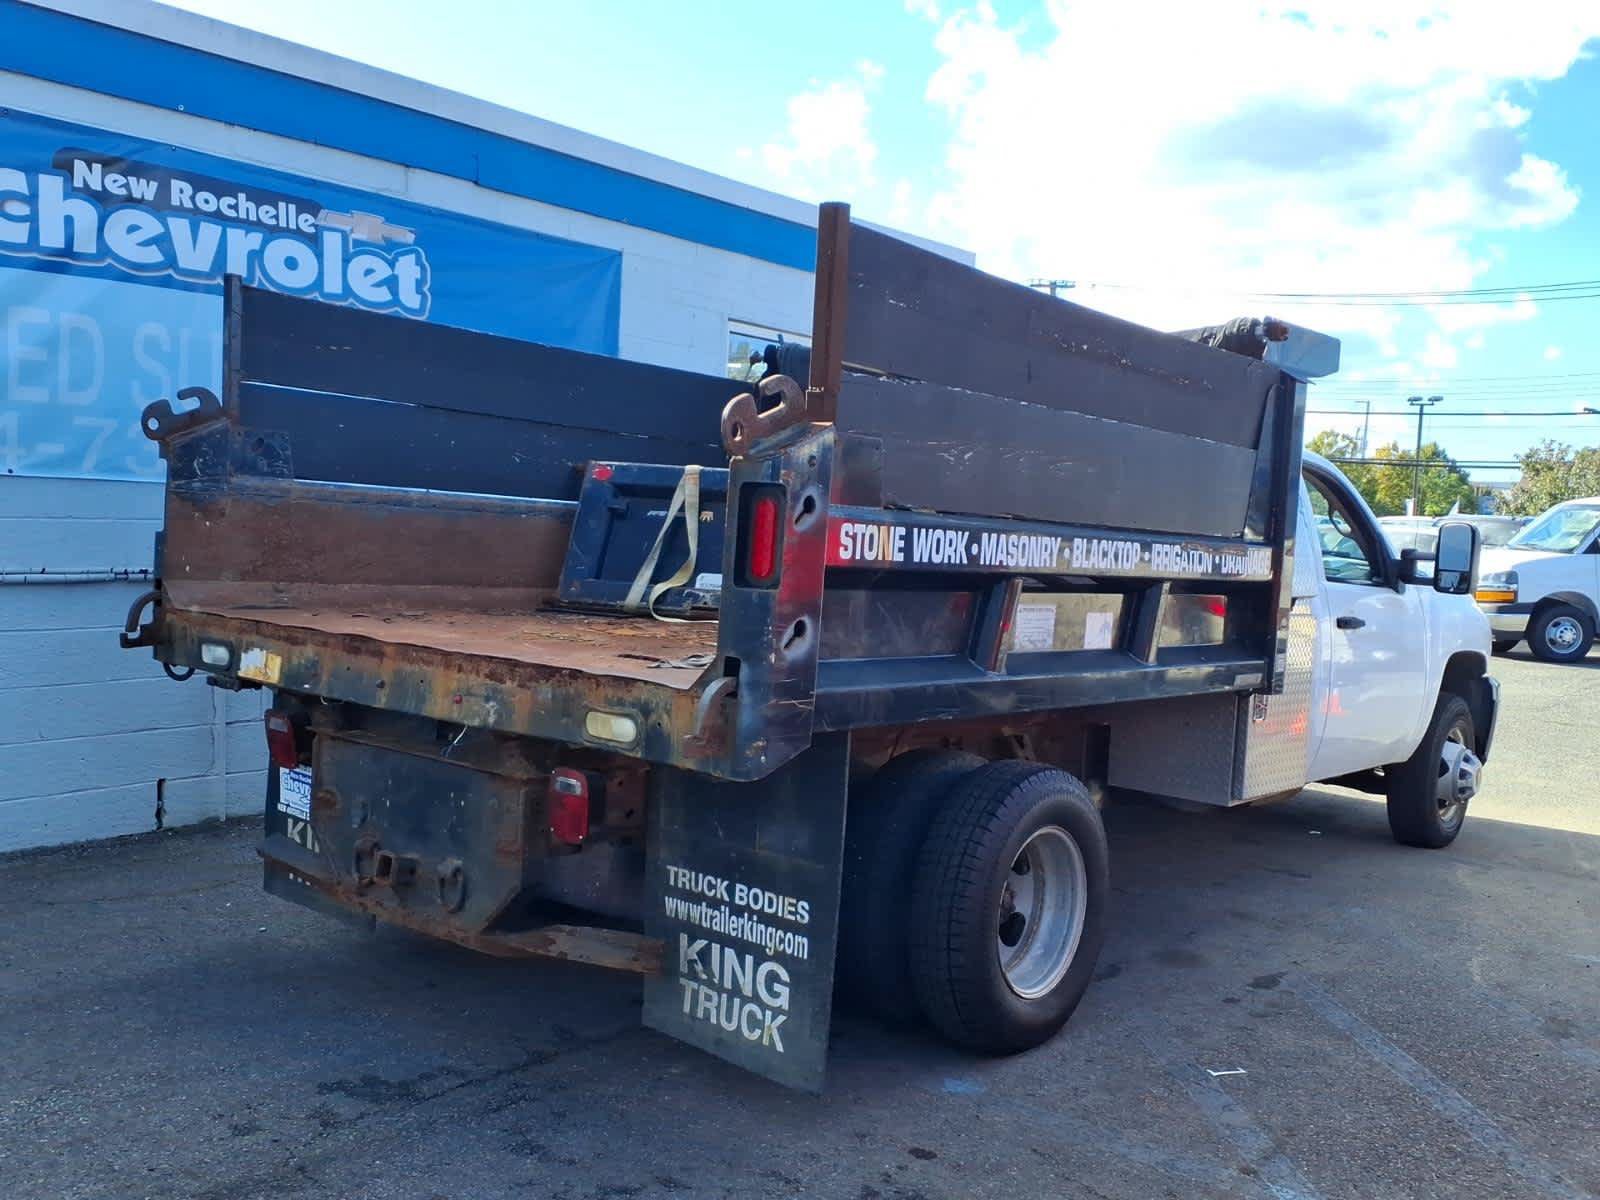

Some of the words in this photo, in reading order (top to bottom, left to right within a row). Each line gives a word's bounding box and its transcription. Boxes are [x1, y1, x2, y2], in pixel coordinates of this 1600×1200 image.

[73, 159, 158, 201] New
[171, 178, 316, 233] Rochelle
[839, 522, 906, 562] STONE
[912, 527, 969, 565] WORK
[980, 532, 1062, 568] MASONRY
[1071, 537, 1141, 569] BLACKTOP
[287, 818, 320, 853] KI
[666, 865, 730, 902] TRUCK
[735, 883, 810, 925] BODIES
[679, 932, 791, 1011] KING
[680, 977, 788, 1053] TRUCK
